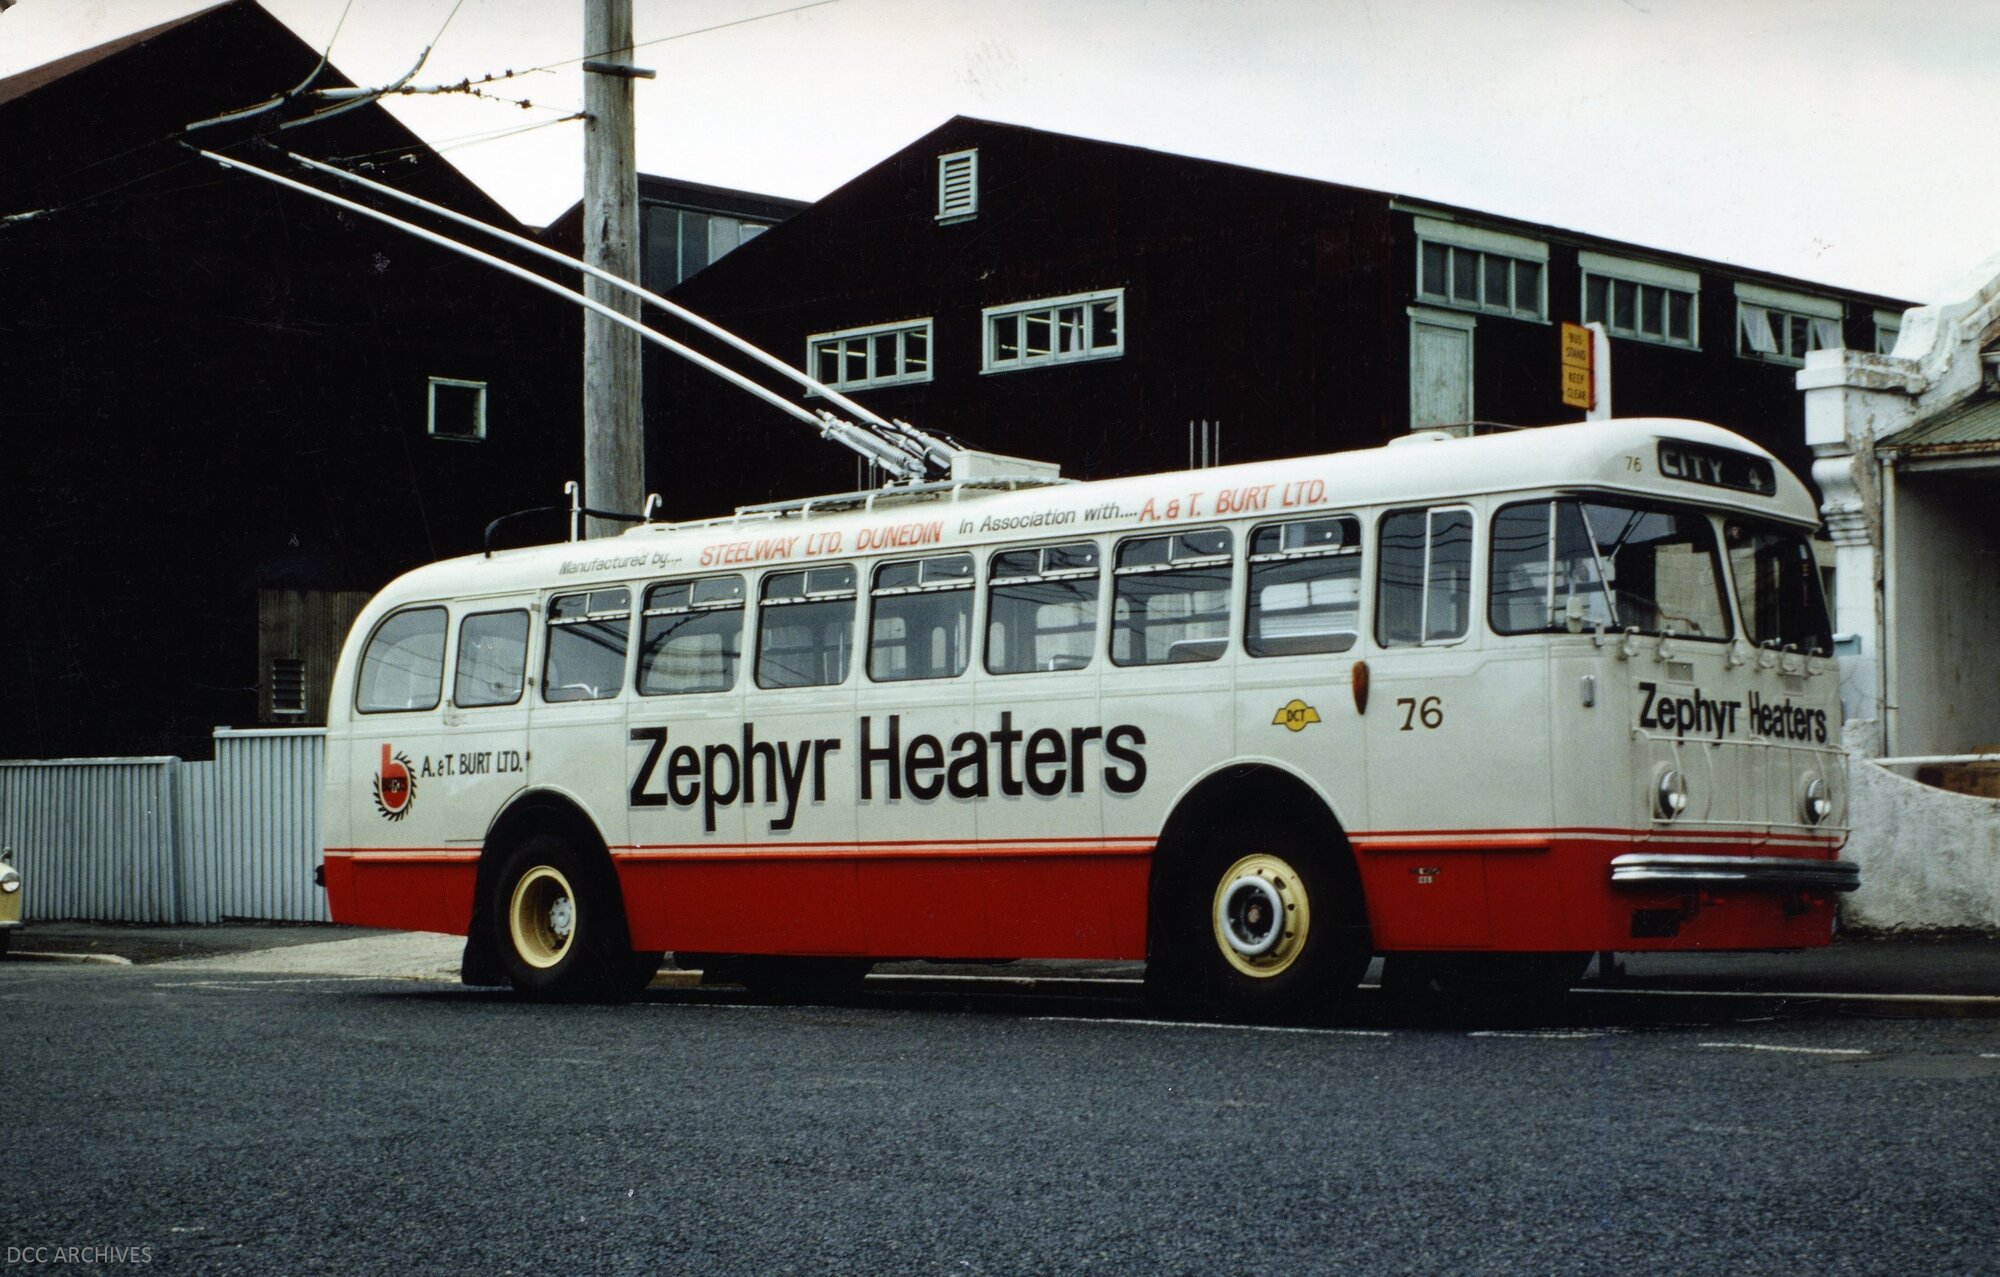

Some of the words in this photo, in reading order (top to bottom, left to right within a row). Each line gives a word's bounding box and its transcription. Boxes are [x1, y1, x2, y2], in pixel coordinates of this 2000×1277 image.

[1625, 456, 1642, 473] 76
[1660, 451, 1723, 484] CITY
[559, 552, 648, 576] Manufactured
[699, 535, 800, 568] STEELWAY
[805, 530, 842, 556] LTD.
[856, 520, 943, 551] DUNEDIN
[959, 517, 973, 535] In
[979, 508, 1076, 533] Association
[1166, 499, 1180, 519] &
[1215, 483, 1277, 514] BURT
[1281, 479, 1328, 507] LTD.
[1286, 709, 1306, 722] DCT
[1397, 695, 1444, 731] 76
[1638, 681, 1742, 746] Zephyr
[1748, 690, 1828, 744] Heaters
[459, 752, 492, 775] BURT
[497, 750, 523, 773] LTD.
[629, 722, 842, 832] Zephyr
[859, 711, 1148, 801] Heaters
